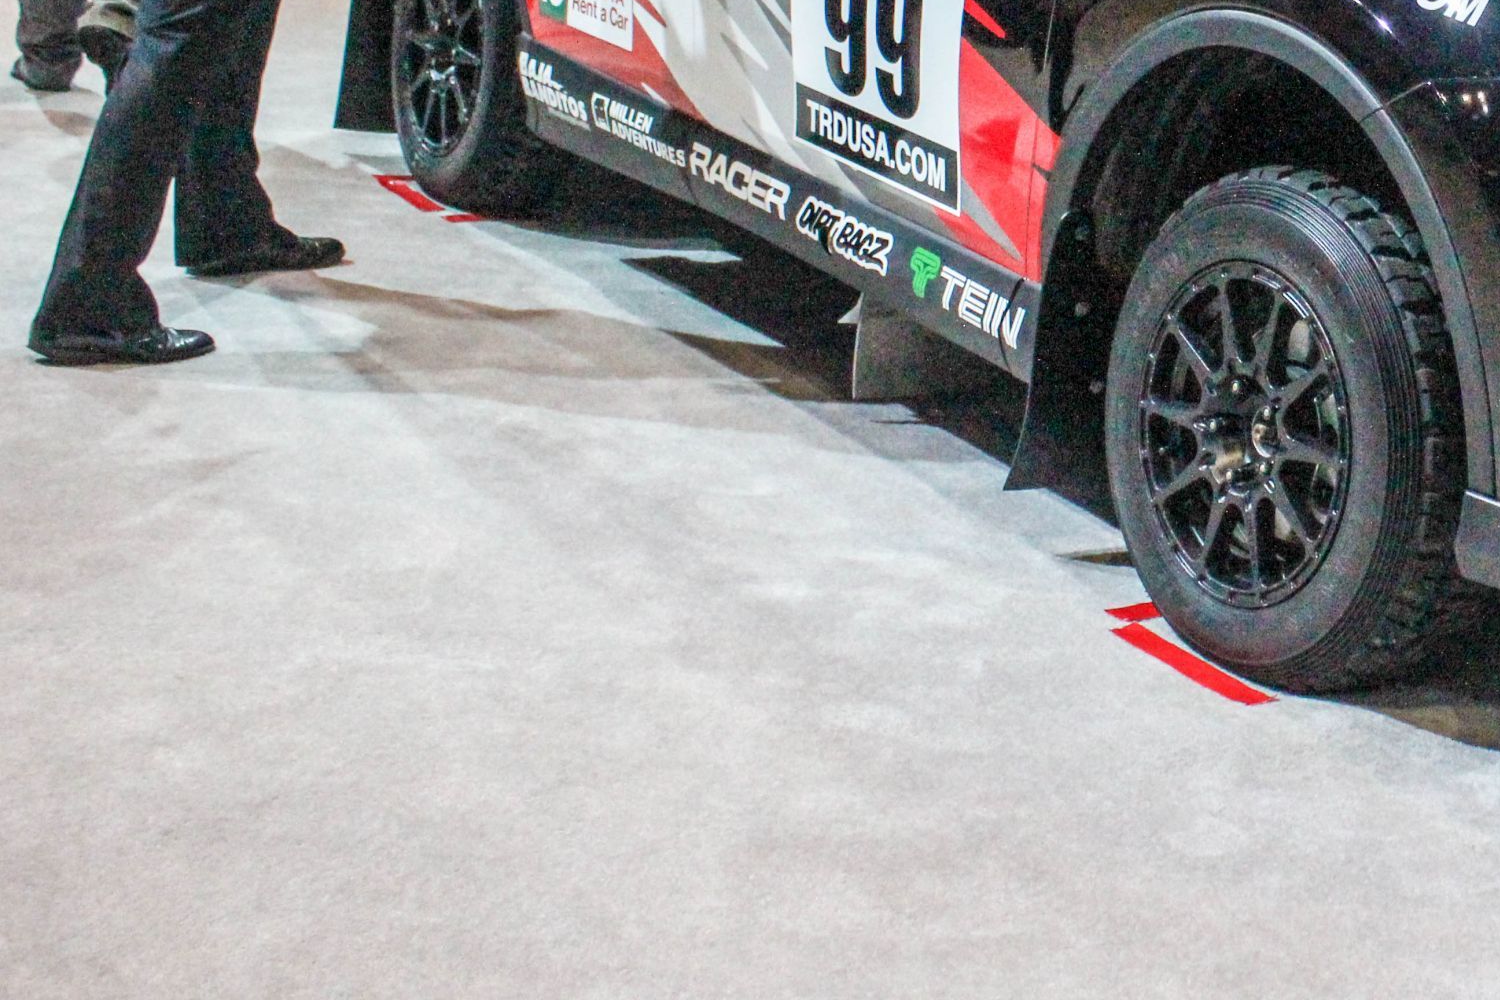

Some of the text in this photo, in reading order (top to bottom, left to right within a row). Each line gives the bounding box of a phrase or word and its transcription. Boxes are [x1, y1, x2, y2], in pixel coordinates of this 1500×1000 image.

[600, 7, 607, 22] a
[609, 6, 629, 31] Car
[608, 100, 654, 134] MILLEN
[611, 120, 686, 158] ADVENTURES
[806, 98, 946, 192] TRDUSA.COM
[690, 142, 790, 220] RACER
[941, 266, 1026, 349] TEIN
